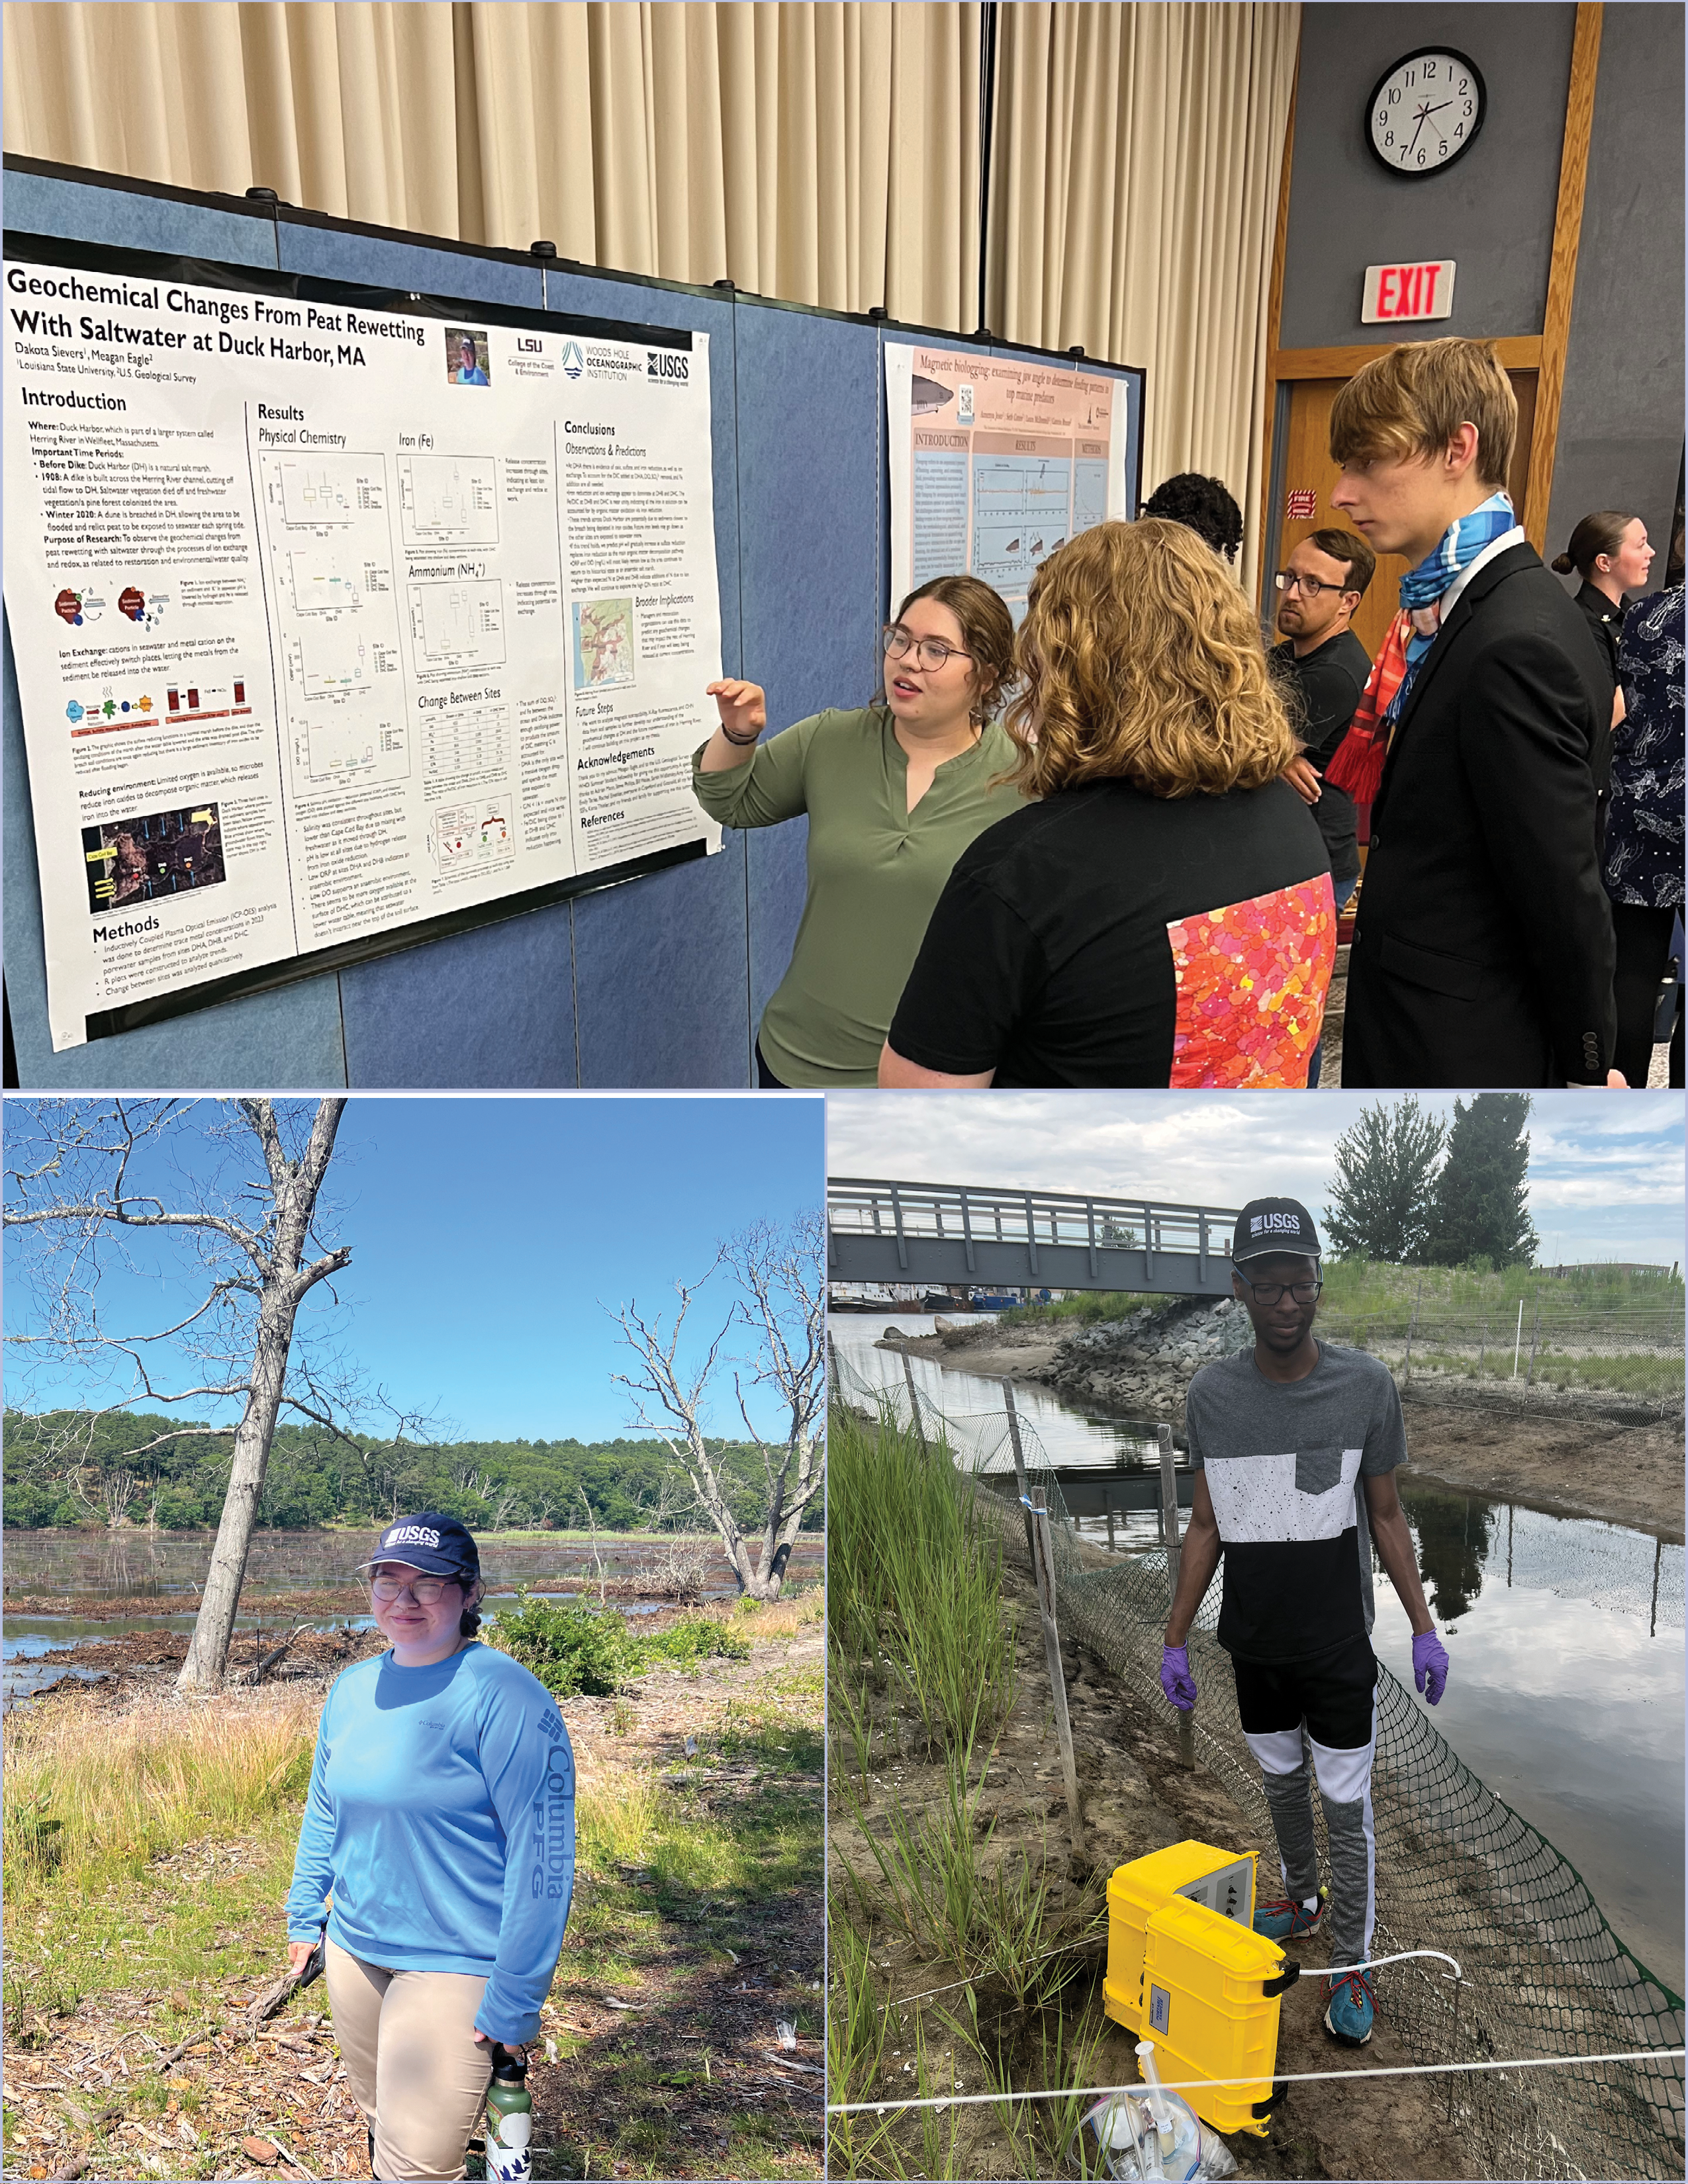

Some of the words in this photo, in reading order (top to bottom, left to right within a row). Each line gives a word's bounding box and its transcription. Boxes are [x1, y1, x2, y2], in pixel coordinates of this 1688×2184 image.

[1424, 62, 1436, 79] 12
[1449, 66, 1452, 81] 1
[1406, 71, 1415, 87] 11
[1458, 79, 1468, 95] 2
[1388, 88, 1401, 105] 10
[1463, 100, 1472, 116] 3
[1380, 110, 1387, 126] 9
[1385, 130, 1393, 146] 8
[1454, 122, 1464, 138] 4
[1400, 145, 1408, 161] 7
[1417, 148, 1426, 164] 6
[1438, 140, 1448, 156] 5
[1377, 266, 1440, 318] EXIT
[7, 269, 159, 310] Geochemical
[167, 289, 249, 324] Changes
[255, 300, 301, 326] From
[307, 308, 342, 332] Peat
[347, 313, 425, 347] Rewetting
[10, 308, 72, 338] With
[79, 316, 187, 349] Saltwater
[193, 333, 213, 352] at
[218, 331, 265, 357] Duck
[270, 337, 334, 367] Harbor,
[338, 344, 366, 367] MA
[518, 338, 542, 353] LSU
[15, 341, 50, 356] Dakota
[91, 349, 124, 364] Meagan
[586, 346, 612, 357] WOODS
[614, 349, 630, 360] HOLE
[508, 359, 526, 369] College
[586, 357, 642, 372] OCEANOGRAPHIC
[659, 353, 688, 379] USGS
[919, 354, 953, 373] Magnetic
[954, 359, 990, 380] biologging:
[992, 368, 1022, 384] examining
[56, 362, 76, 373] State
[77, 365, 115, 379] University,
[134, 369, 171, 383] Geological
[173, 373, 197, 385] Survey
[587, 369, 627, 381] INSTITUTION
[22, 387, 126, 411] Introduction
[258, 403, 304, 421] Results
[28, 421, 59, 430] Where:
[60, 422, 78, 432] Duck
[145, 427, 151, 435] of
[158, 428, 175, 438] larger
[565, 420, 615, 436] Conclusions
[30, 434, 58, 446] Herring
[58, 435, 76, 444] River
[259, 428, 296, 445] Physical
[299, 430, 346, 449] Chemistry
[399, 432, 416, 446] Iron
[418, 433, 434, 450] (Fe)
[915, 433, 968, 447] INTRODUCTION
[1015, 439, 1036, 451] RESULTS
[32, 447, 73, 458] Important
[73, 448, 93, 457] Time
[95, 449, 124, 458] Periods:
[565, 442, 606, 456] Observations
[608, 444, 614, 456] &
[615, 444, 646, 457] Predictions
[39, 460, 66, 469] Before
[88, 461, 106, 470] Duck
[131, 462, 147, 472] (DH)
[408, 565, 455, 578] Ammonium
[635, 596, 659, 608] Broader
[659, 594, 694, 607] Implications
[59, 650, 71, 659] Ion
[71, 648, 108, 657] Exchange:
[167, 640, 179, 649] and
[418, 696, 447, 709] Change
[450, 692, 482, 704] Between
[484, 688, 501, 700] Sites
[575, 706, 596, 717] Future
[597, 703, 614, 715] Steps
[577, 747, 655, 771] Acknowledgements
[332, 817, 355, 827] consistent
[356, 811, 382, 822] throughout
[581, 811, 625, 829] References
[93, 915, 160, 943] Methods
[104, 939, 138, 953] Inductively
[138, 932, 164, 944] Coupled
[165, 928, 185, 937] Plasma
[185, 921, 205, 932] Optical
[206, 915, 229, 926] Emission
[258, 903, 277, 913] analysis
[1264, 1213, 1300, 1230] USGS
[399, 1525, 440, 1543] USGS
[547, 1745, 573, 1900] Columbia
[532, 1802, 548, 1900] PFG
